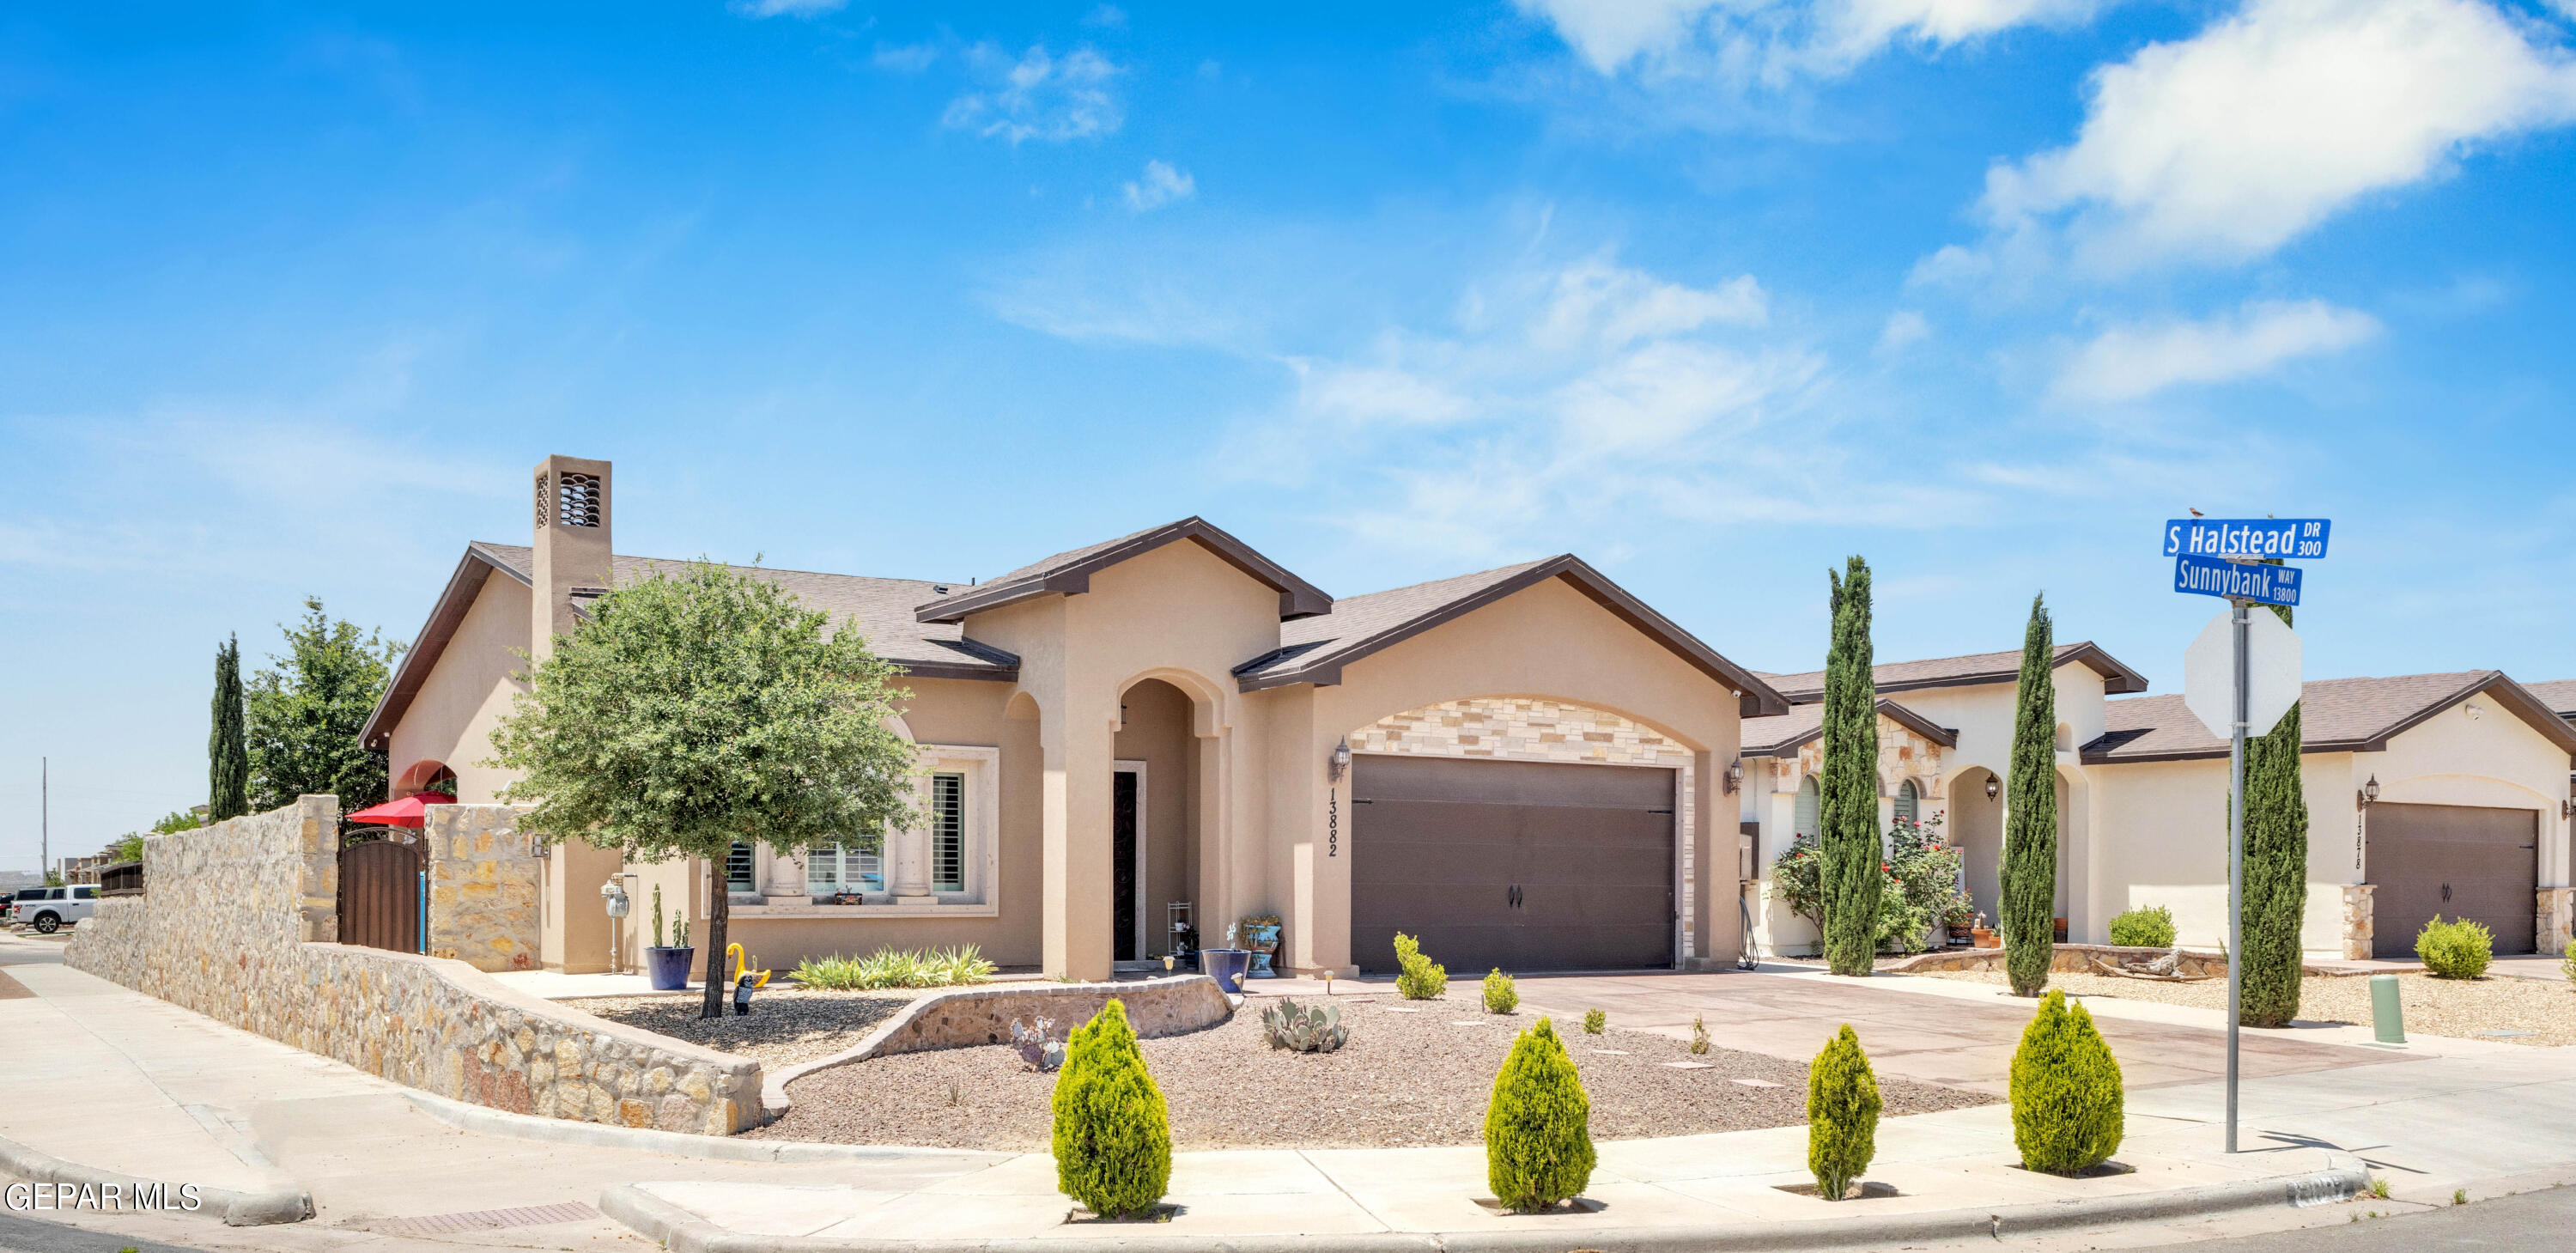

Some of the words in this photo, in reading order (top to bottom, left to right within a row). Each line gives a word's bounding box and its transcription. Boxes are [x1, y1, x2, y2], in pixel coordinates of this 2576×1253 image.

[2167, 526, 2181, 553] S
[2190, 524, 2297, 554] Halstead
[2303, 522, 2321, 538] DR
[2297, 541, 2322, 557] 300
[2178, 559, 2271, 598] Sunnybank
[2278, 569, 2295, 585] WAY
[2273, 587, 2297, 603] 13800
[1328, 788, 1337, 857] 13882
